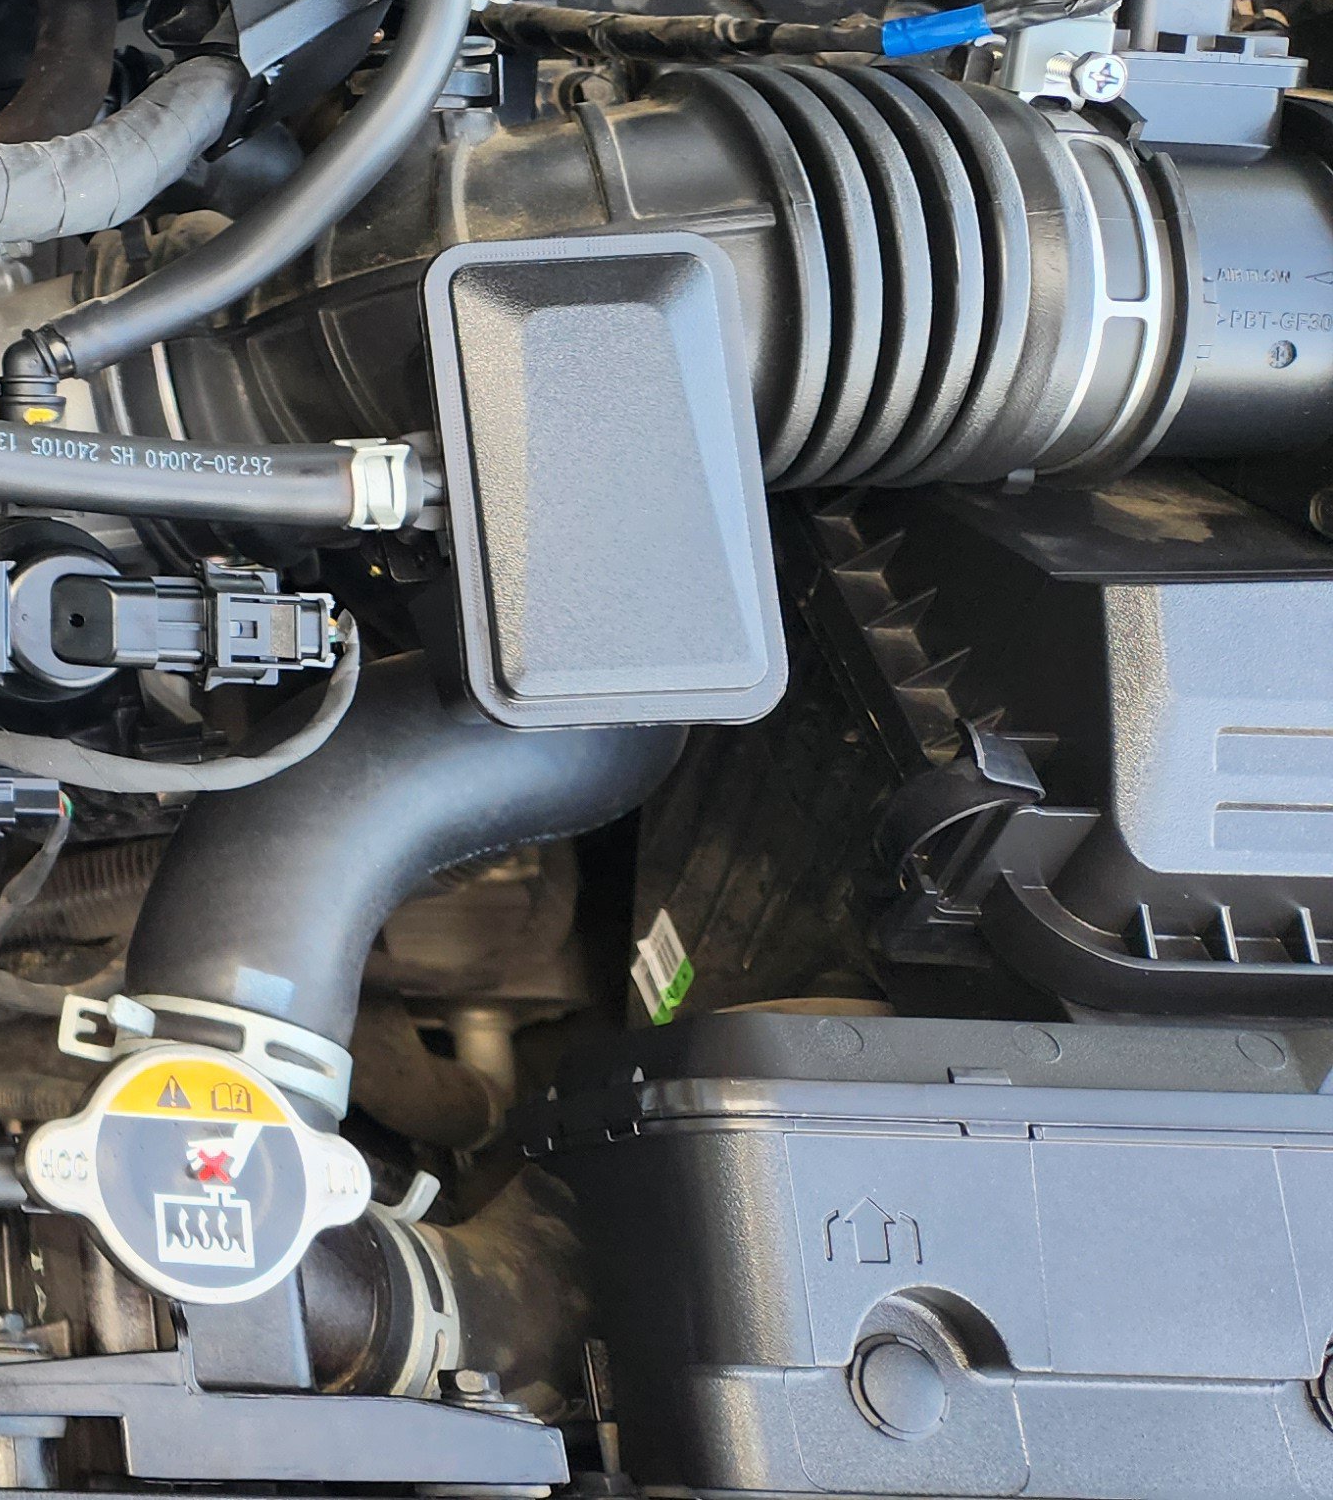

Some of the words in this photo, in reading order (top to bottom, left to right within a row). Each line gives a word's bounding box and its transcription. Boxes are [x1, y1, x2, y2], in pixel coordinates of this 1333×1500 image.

[1217, 268, 1243, 282] AIR
[30, 436, 99, 462] 240105
[109, 445, 134, 467] HS
[145, 448, 275, 477] 26730-2J040
[39, 1148, 89, 1182] HCC
